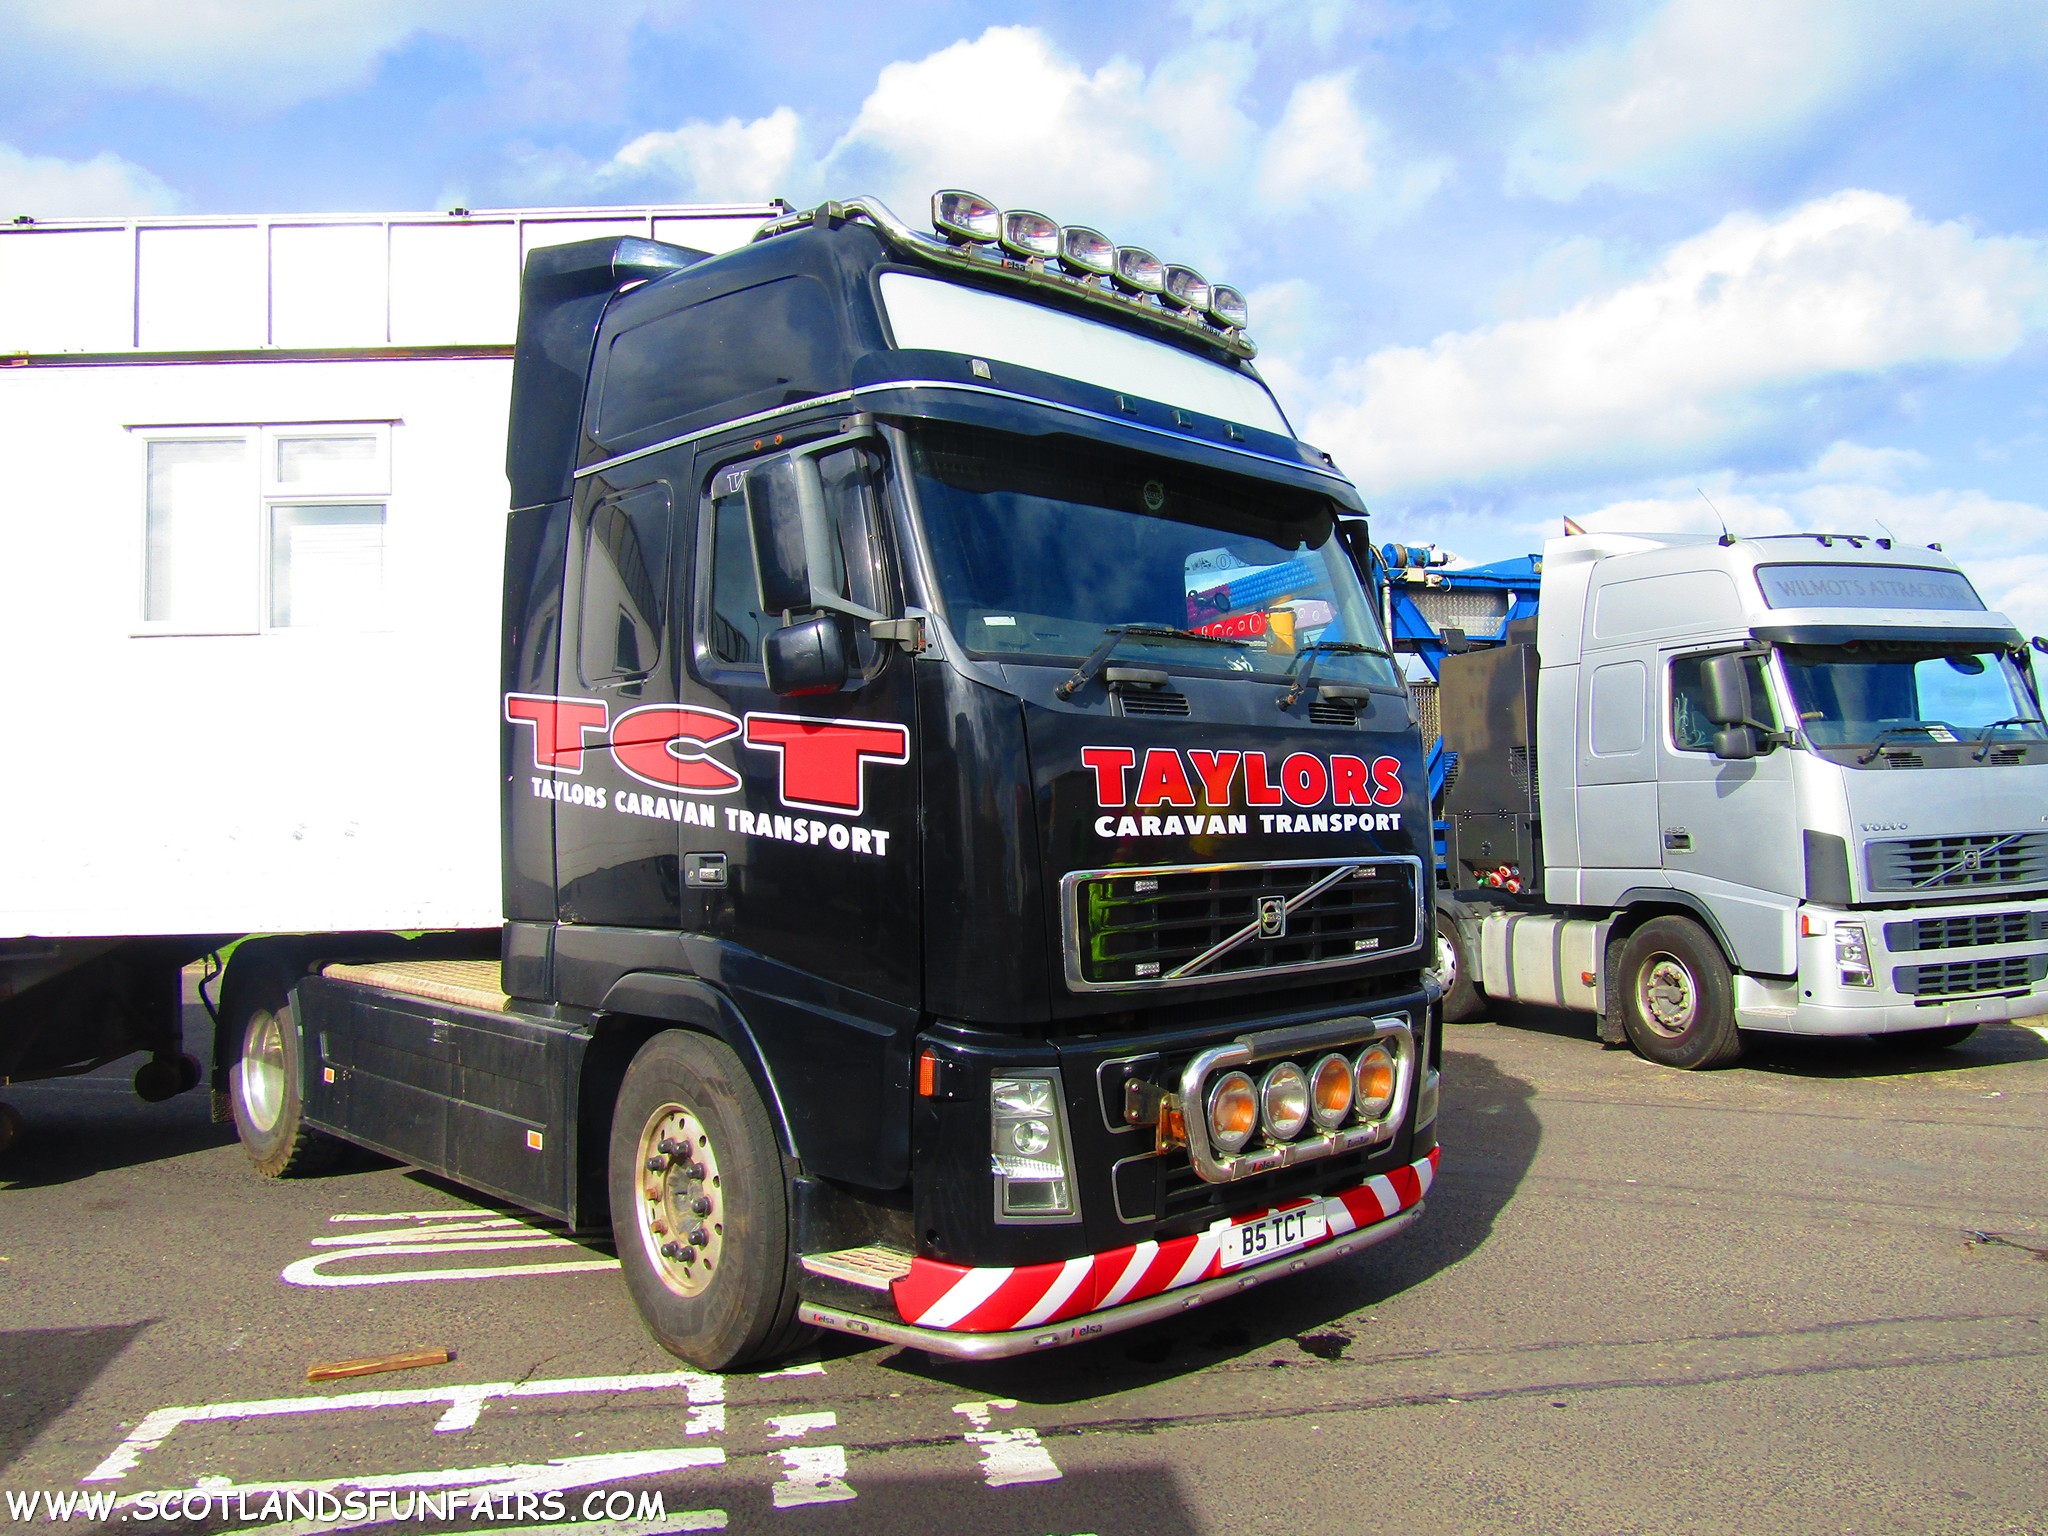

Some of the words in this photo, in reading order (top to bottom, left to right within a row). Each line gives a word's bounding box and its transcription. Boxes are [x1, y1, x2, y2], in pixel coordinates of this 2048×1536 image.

[1776, 579, 1866, 598] WILMOT'S
[505, 692, 910, 816] TCT
[1081, 746, 1403, 808] TAYLORS
[531, 776, 607, 808] TAYLORS
[614, 790, 716, 828] CARAVAN
[725, 807, 891, 857] TRANSPORT
[1094, 814, 1247, 838] CARAVAN
[1259, 813, 1401, 834] TRANSPORT
[1860, 822, 1908, 832] VOLVO
[1242, 1222, 1267, 1256] B5
[1272, 1210, 1307, 1246] TCT
